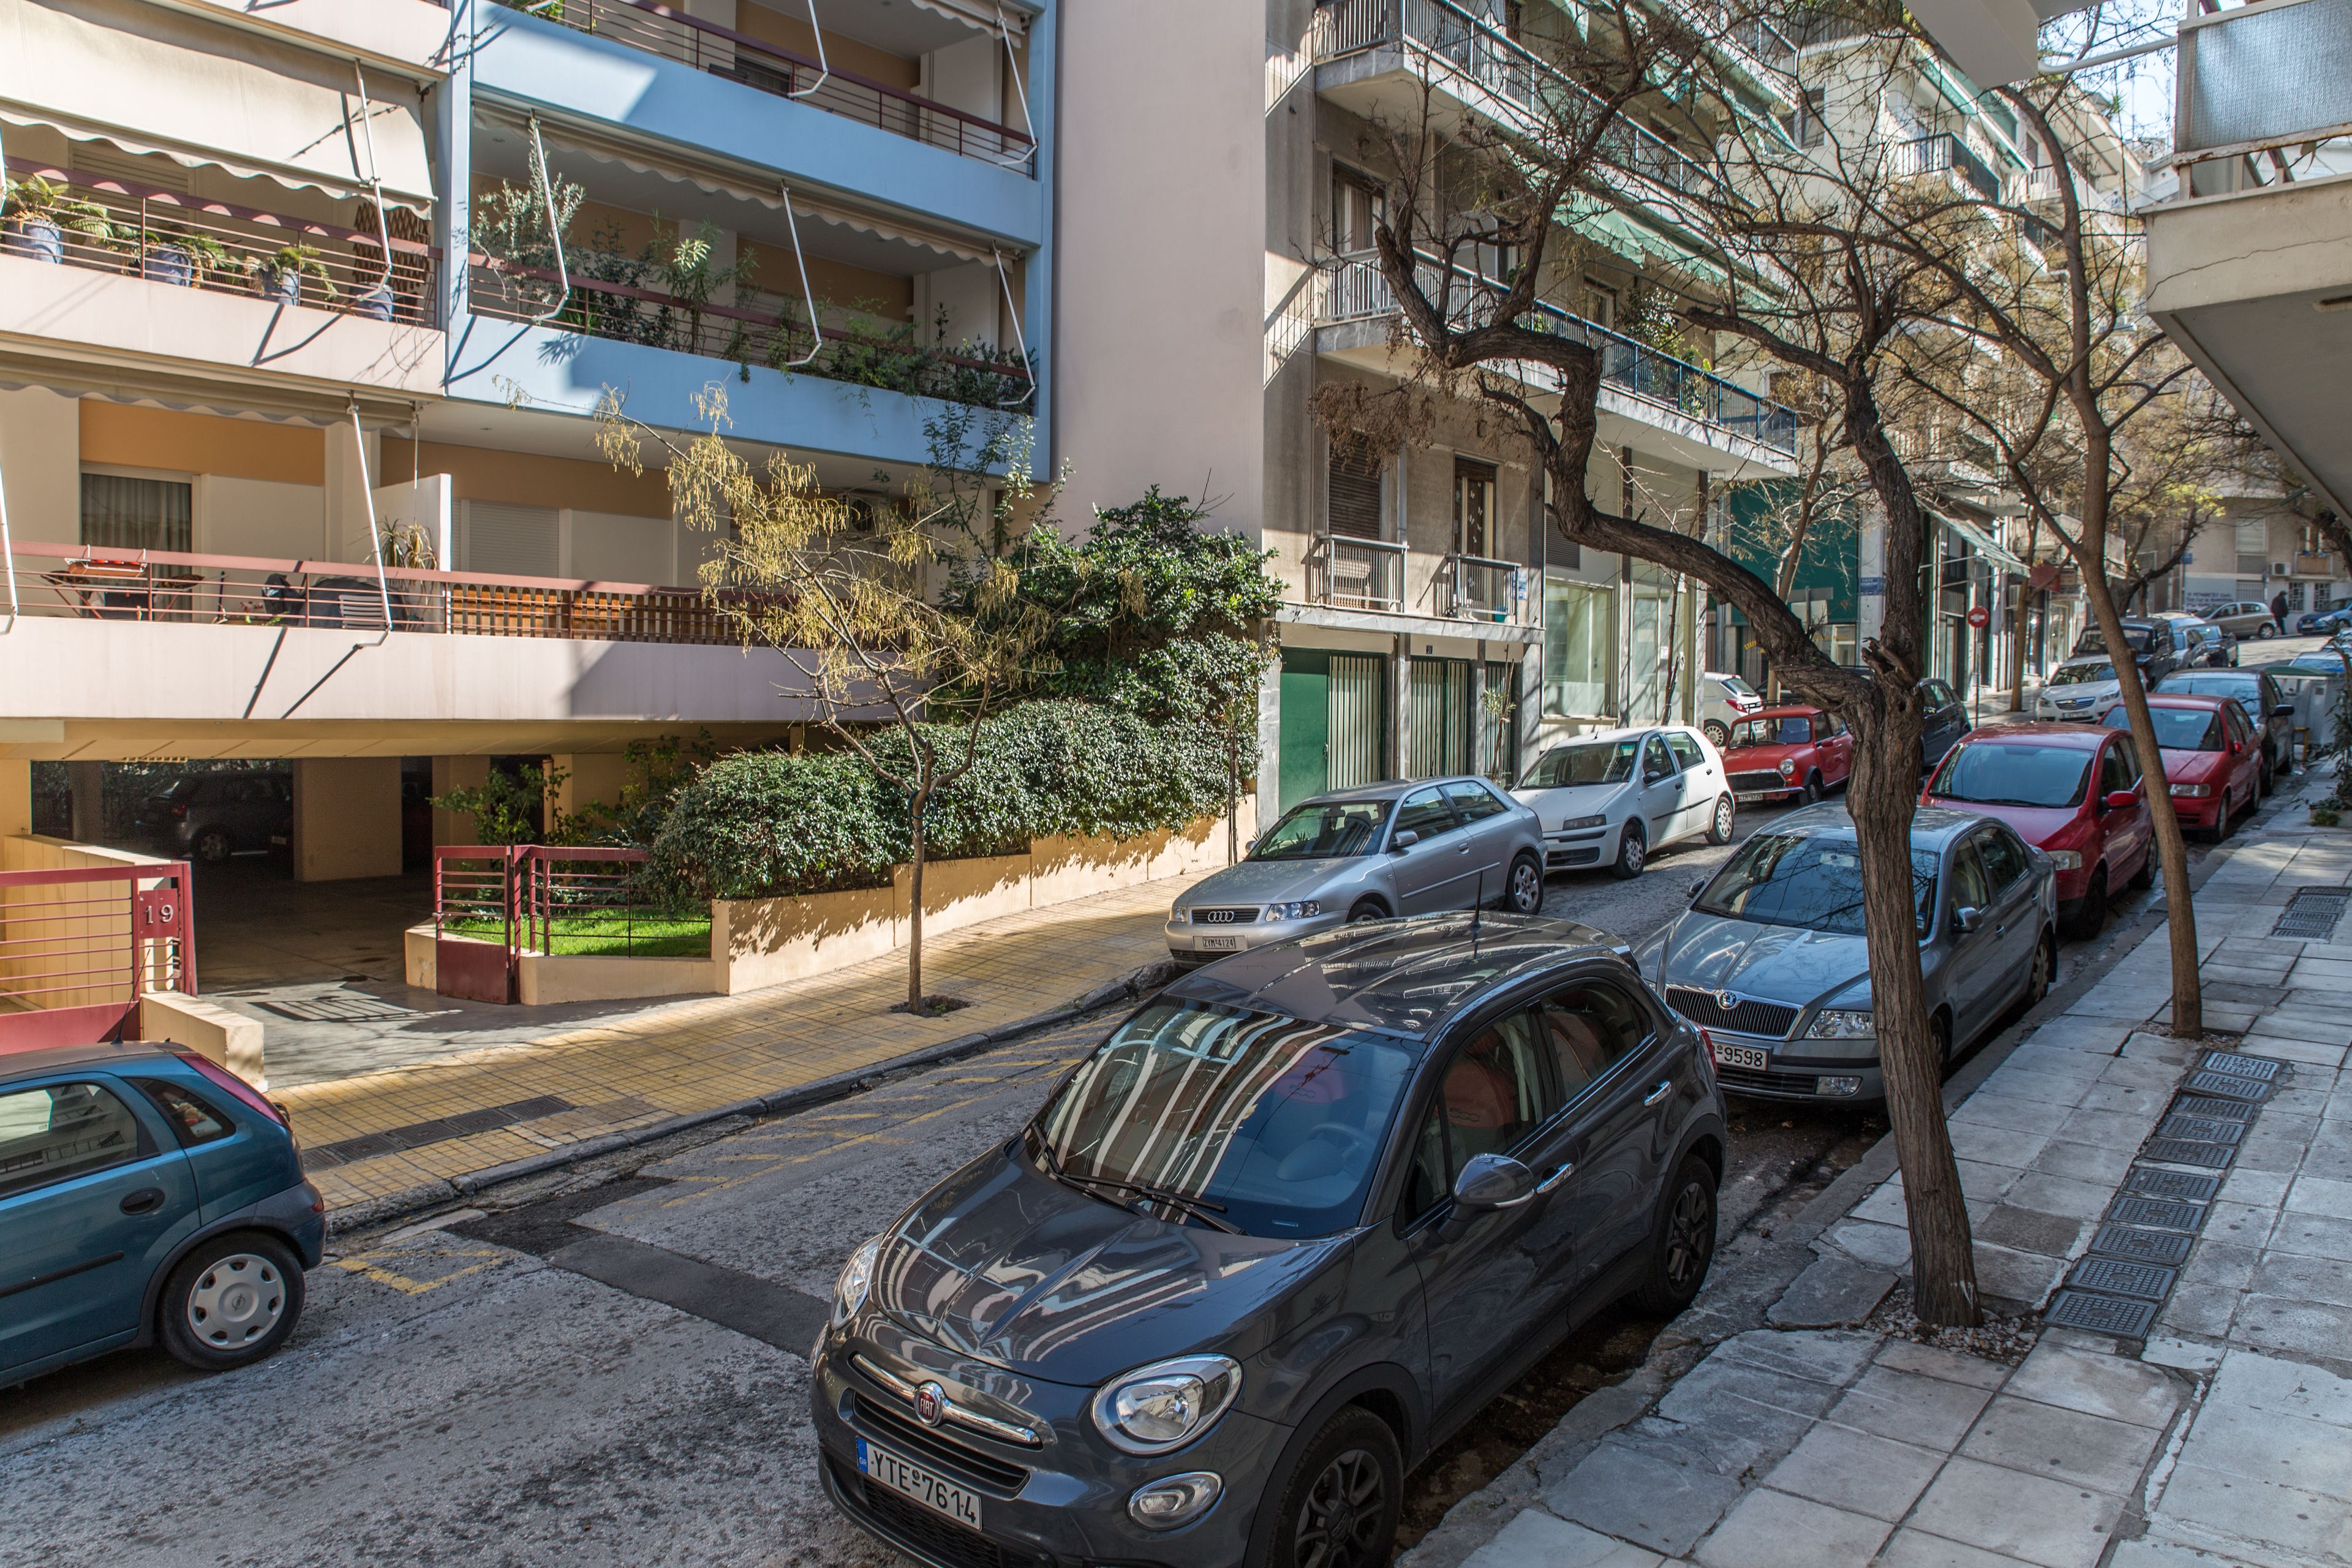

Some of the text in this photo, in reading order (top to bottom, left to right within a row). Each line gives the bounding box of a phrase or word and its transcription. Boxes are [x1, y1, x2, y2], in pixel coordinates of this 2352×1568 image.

[145, 904, 174, 924] 19
[919, 1397, 934, 1417] FIAT
[859, 1457, 867, 1467] GR
